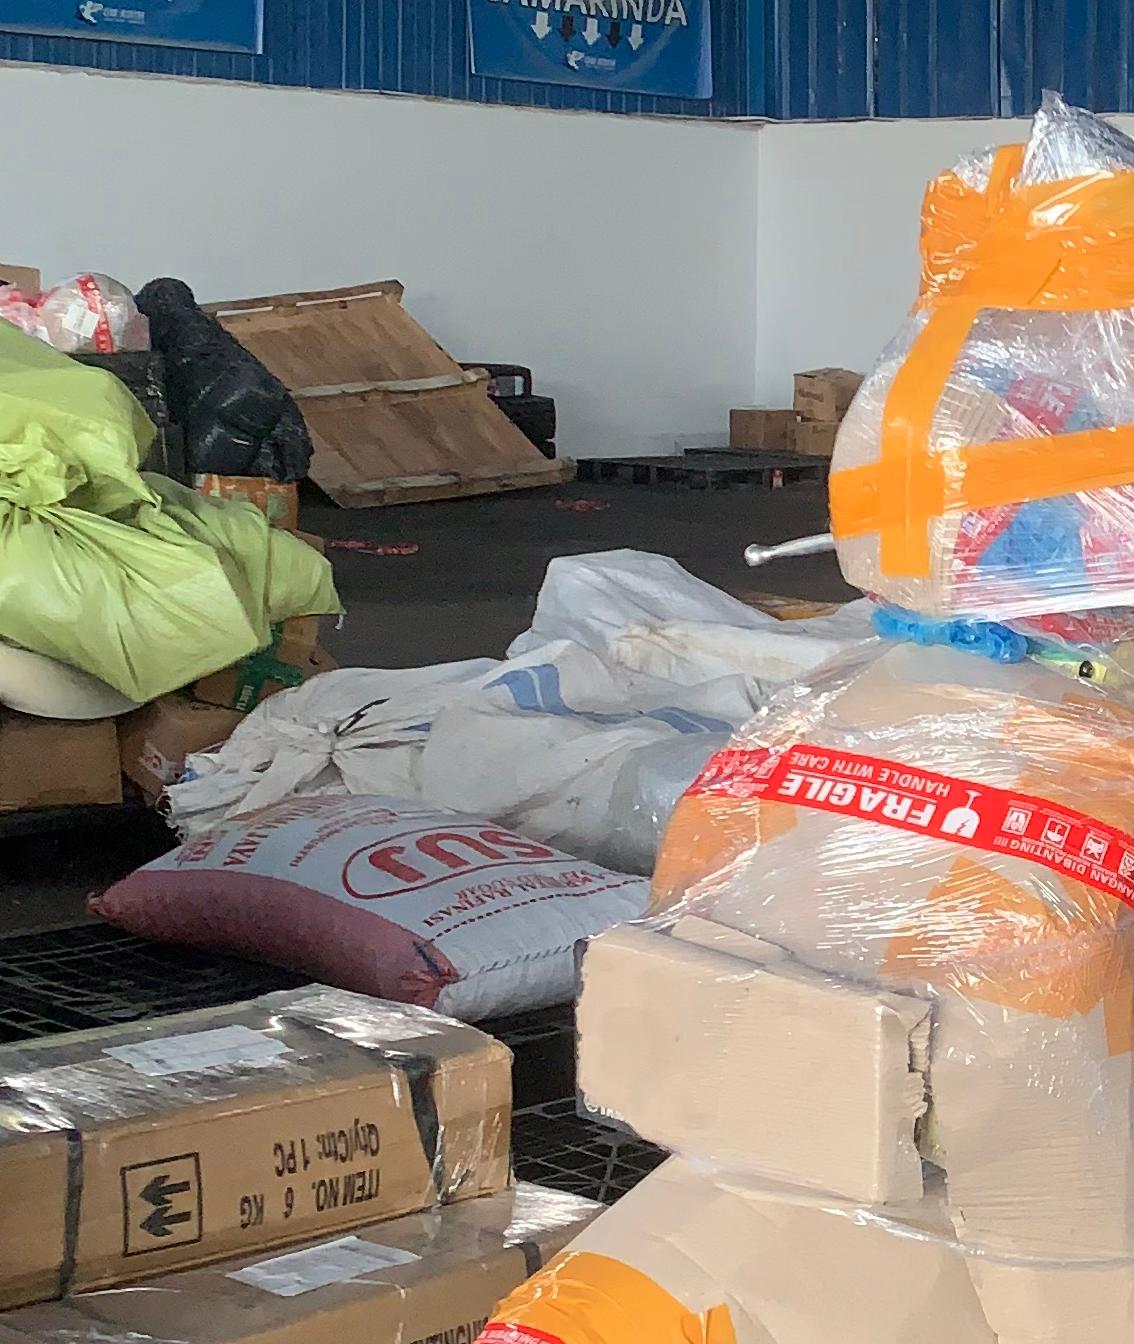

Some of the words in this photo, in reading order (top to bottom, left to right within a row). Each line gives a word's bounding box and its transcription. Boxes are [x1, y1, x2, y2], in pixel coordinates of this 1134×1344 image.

[789, 750, 829, 772] CARE
[832, 757, 876, 782] WITH
[777, 771, 938, 827] FRAGILE
[880, 767, 950, 798] HANDLE
[368, 830, 554, 883] SUJ
[1010, 838, 1087, 876] DIBANTING
[273, 1140, 297, 1177] PC
[301, 1138, 311, 1171] 1
[283, 1186, 294, 1219] 6
[311, 1177, 340, 1212] NO.
[343, 1168, 381, 1206] ITEM
[239, 1193, 264, 1229] KG
